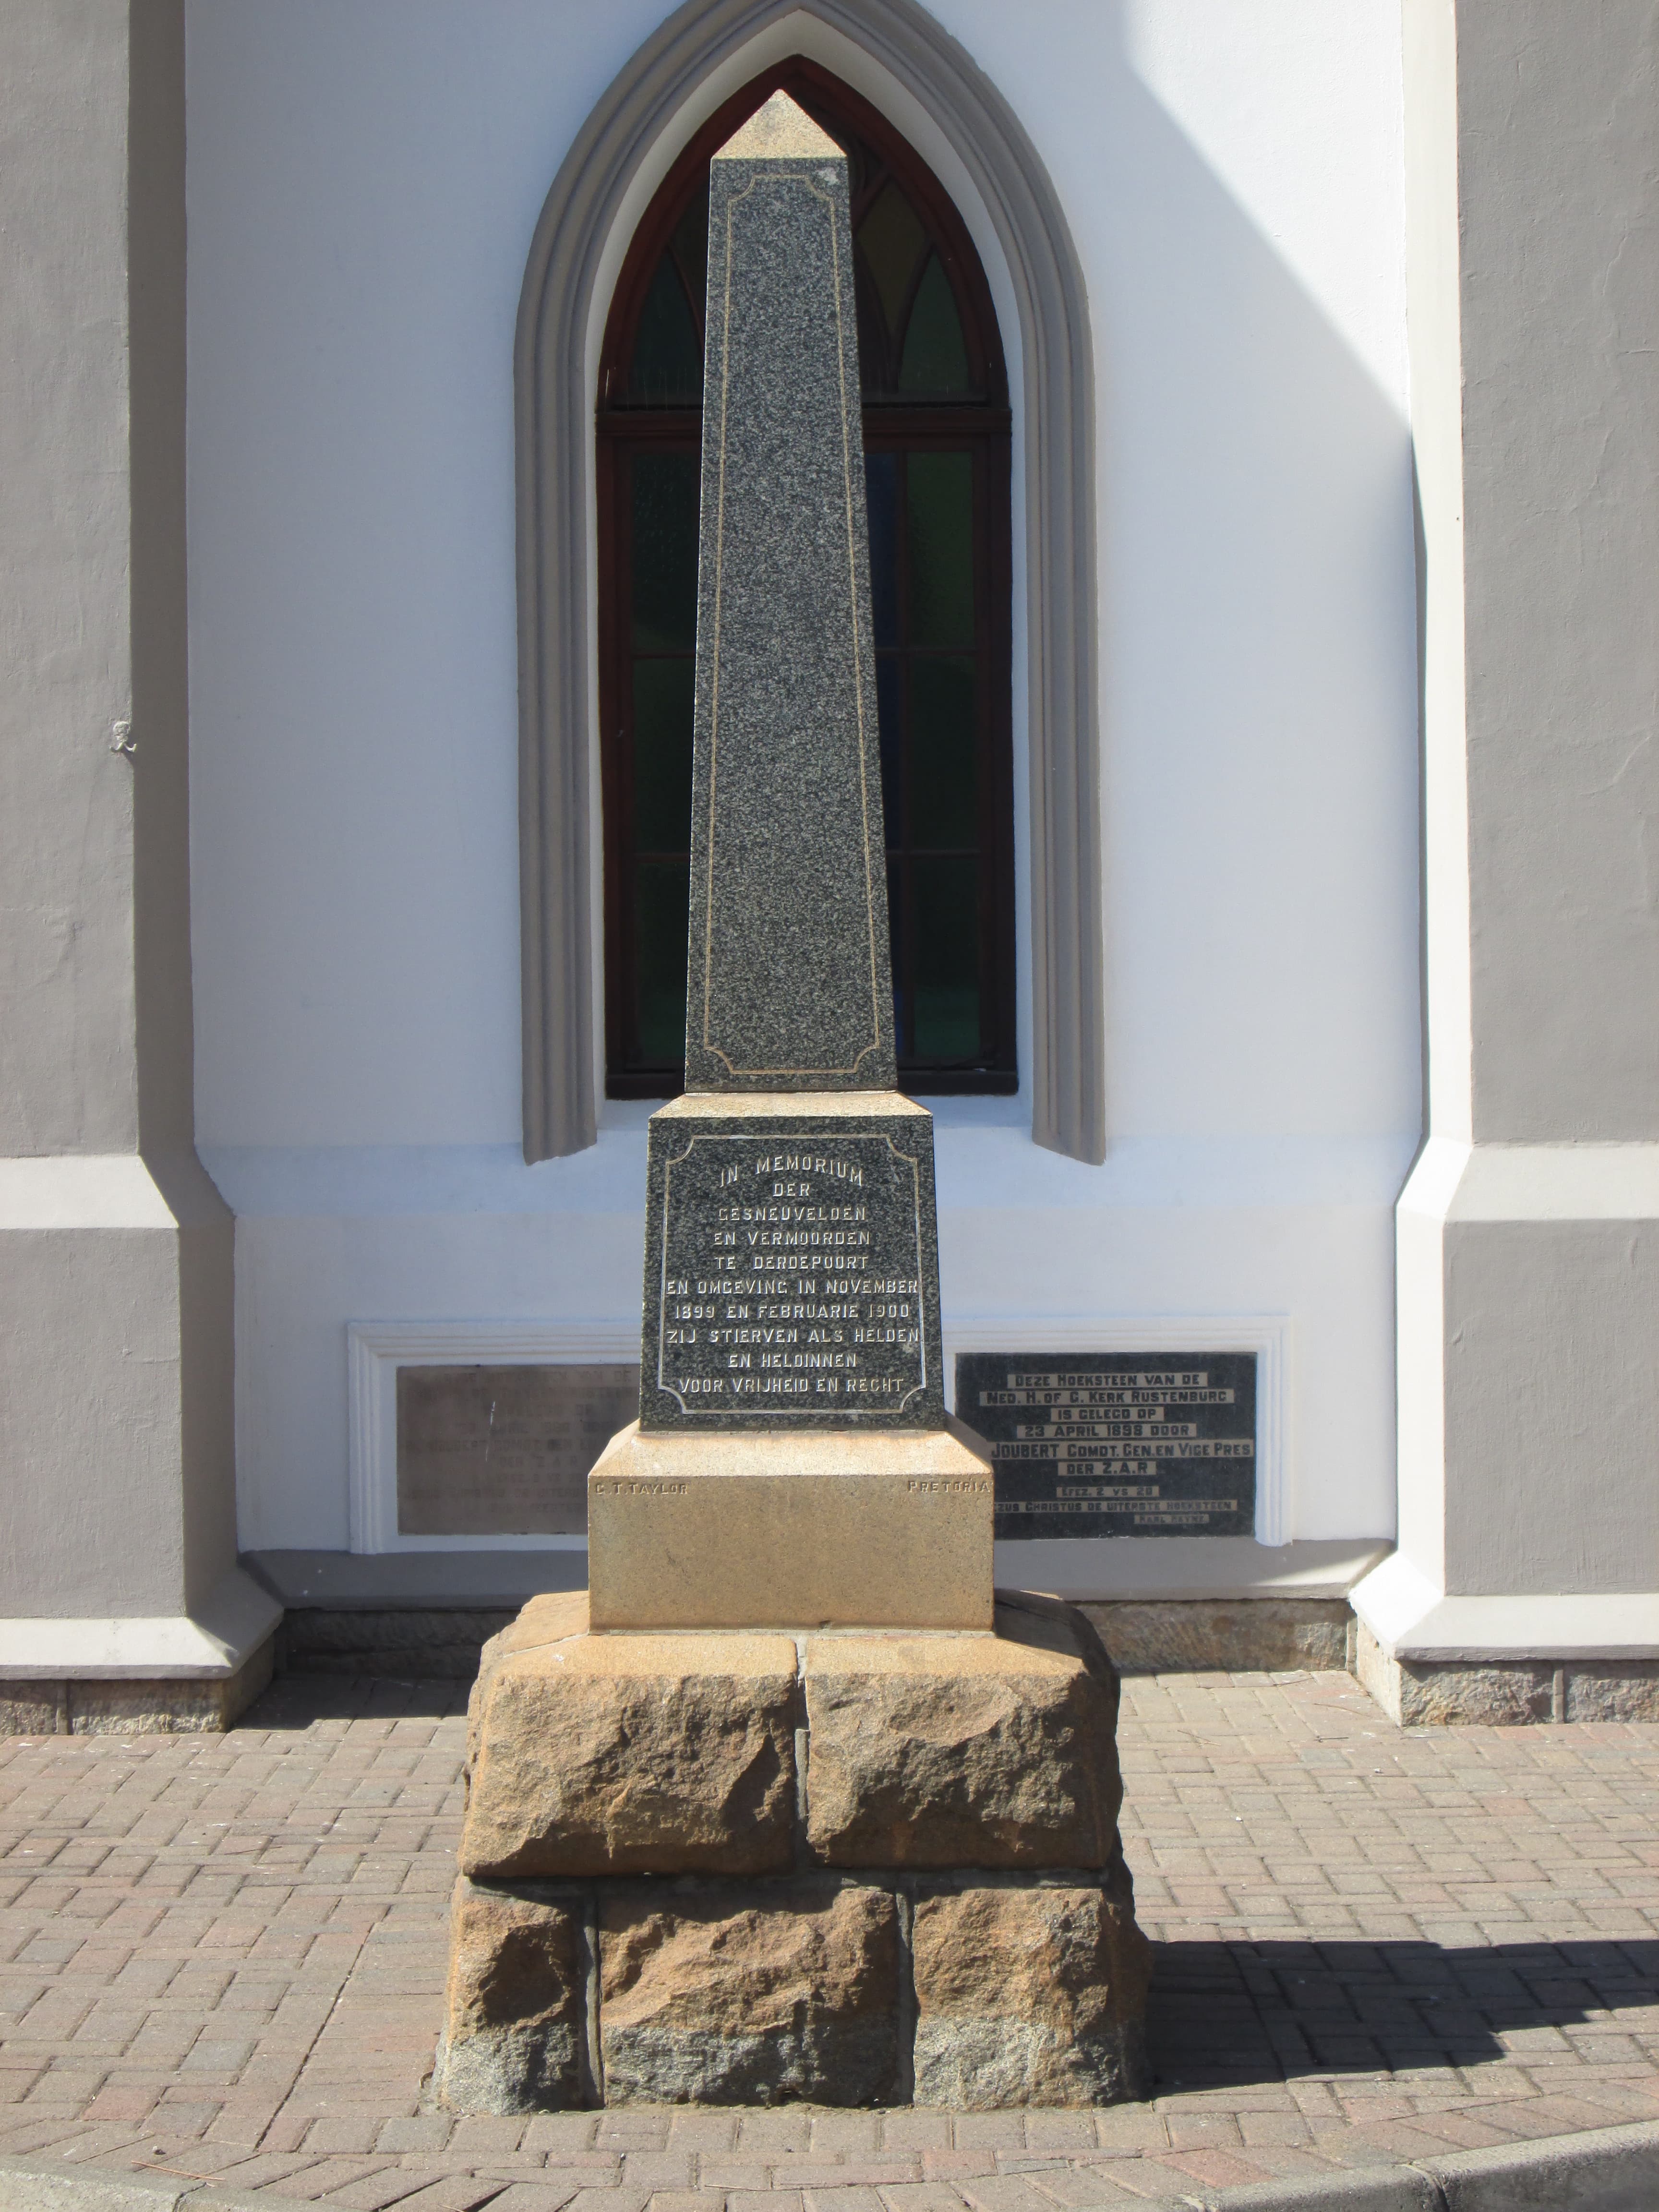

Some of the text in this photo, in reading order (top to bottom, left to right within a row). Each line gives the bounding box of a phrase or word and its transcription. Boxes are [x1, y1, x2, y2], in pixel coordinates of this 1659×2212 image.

[720, 1154, 863, 1188] IN MEMORIUM
[772, 1183, 810, 1197] DER
[719, 1207, 866, 1222] GESNEUVELDEN
[713, 1231, 870, 1246] EN VERMOORDEN
[714, 1255, 868, 1270] TE DERDEPOORT
[666, 1279, 918, 1295] EN OMGEVING IN NOVEMBER
[675, 1304, 910, 1319] 1899 EN FEBRUARIE 1900
[666, 1328, 921, 1344] ZIJ STIERVEN ALS HELDEN
[728, 1353, 857, 1368] EN HELDINNEN
[678, 1378, 904, 1393] VOOR VRIJHEID EN RECHT
[1015, 1374, 1200, 1387] DEZE HOEKSTEEN VAN DE
[1089, 1391, 1125, 1403] KERK
[1058, 1409, 1072, 1420] IS
[1137, 1408, 1156, 1419] OP
[1025, 1426, 1045, 1437] 23
[1054, 1425, 1099, 1437] APRIL
[1151, 1425, 1189, 1436] DOOR
[991, 1443, 1060, 1458] JOUBERT
[1214, 1442, 1250, 1456] PRES
[1067, 1463, 1094, 1475] DER
[908, 1480, 990, 1493] PRETORIA
[1096, 1487, 1104, 1496] 2
